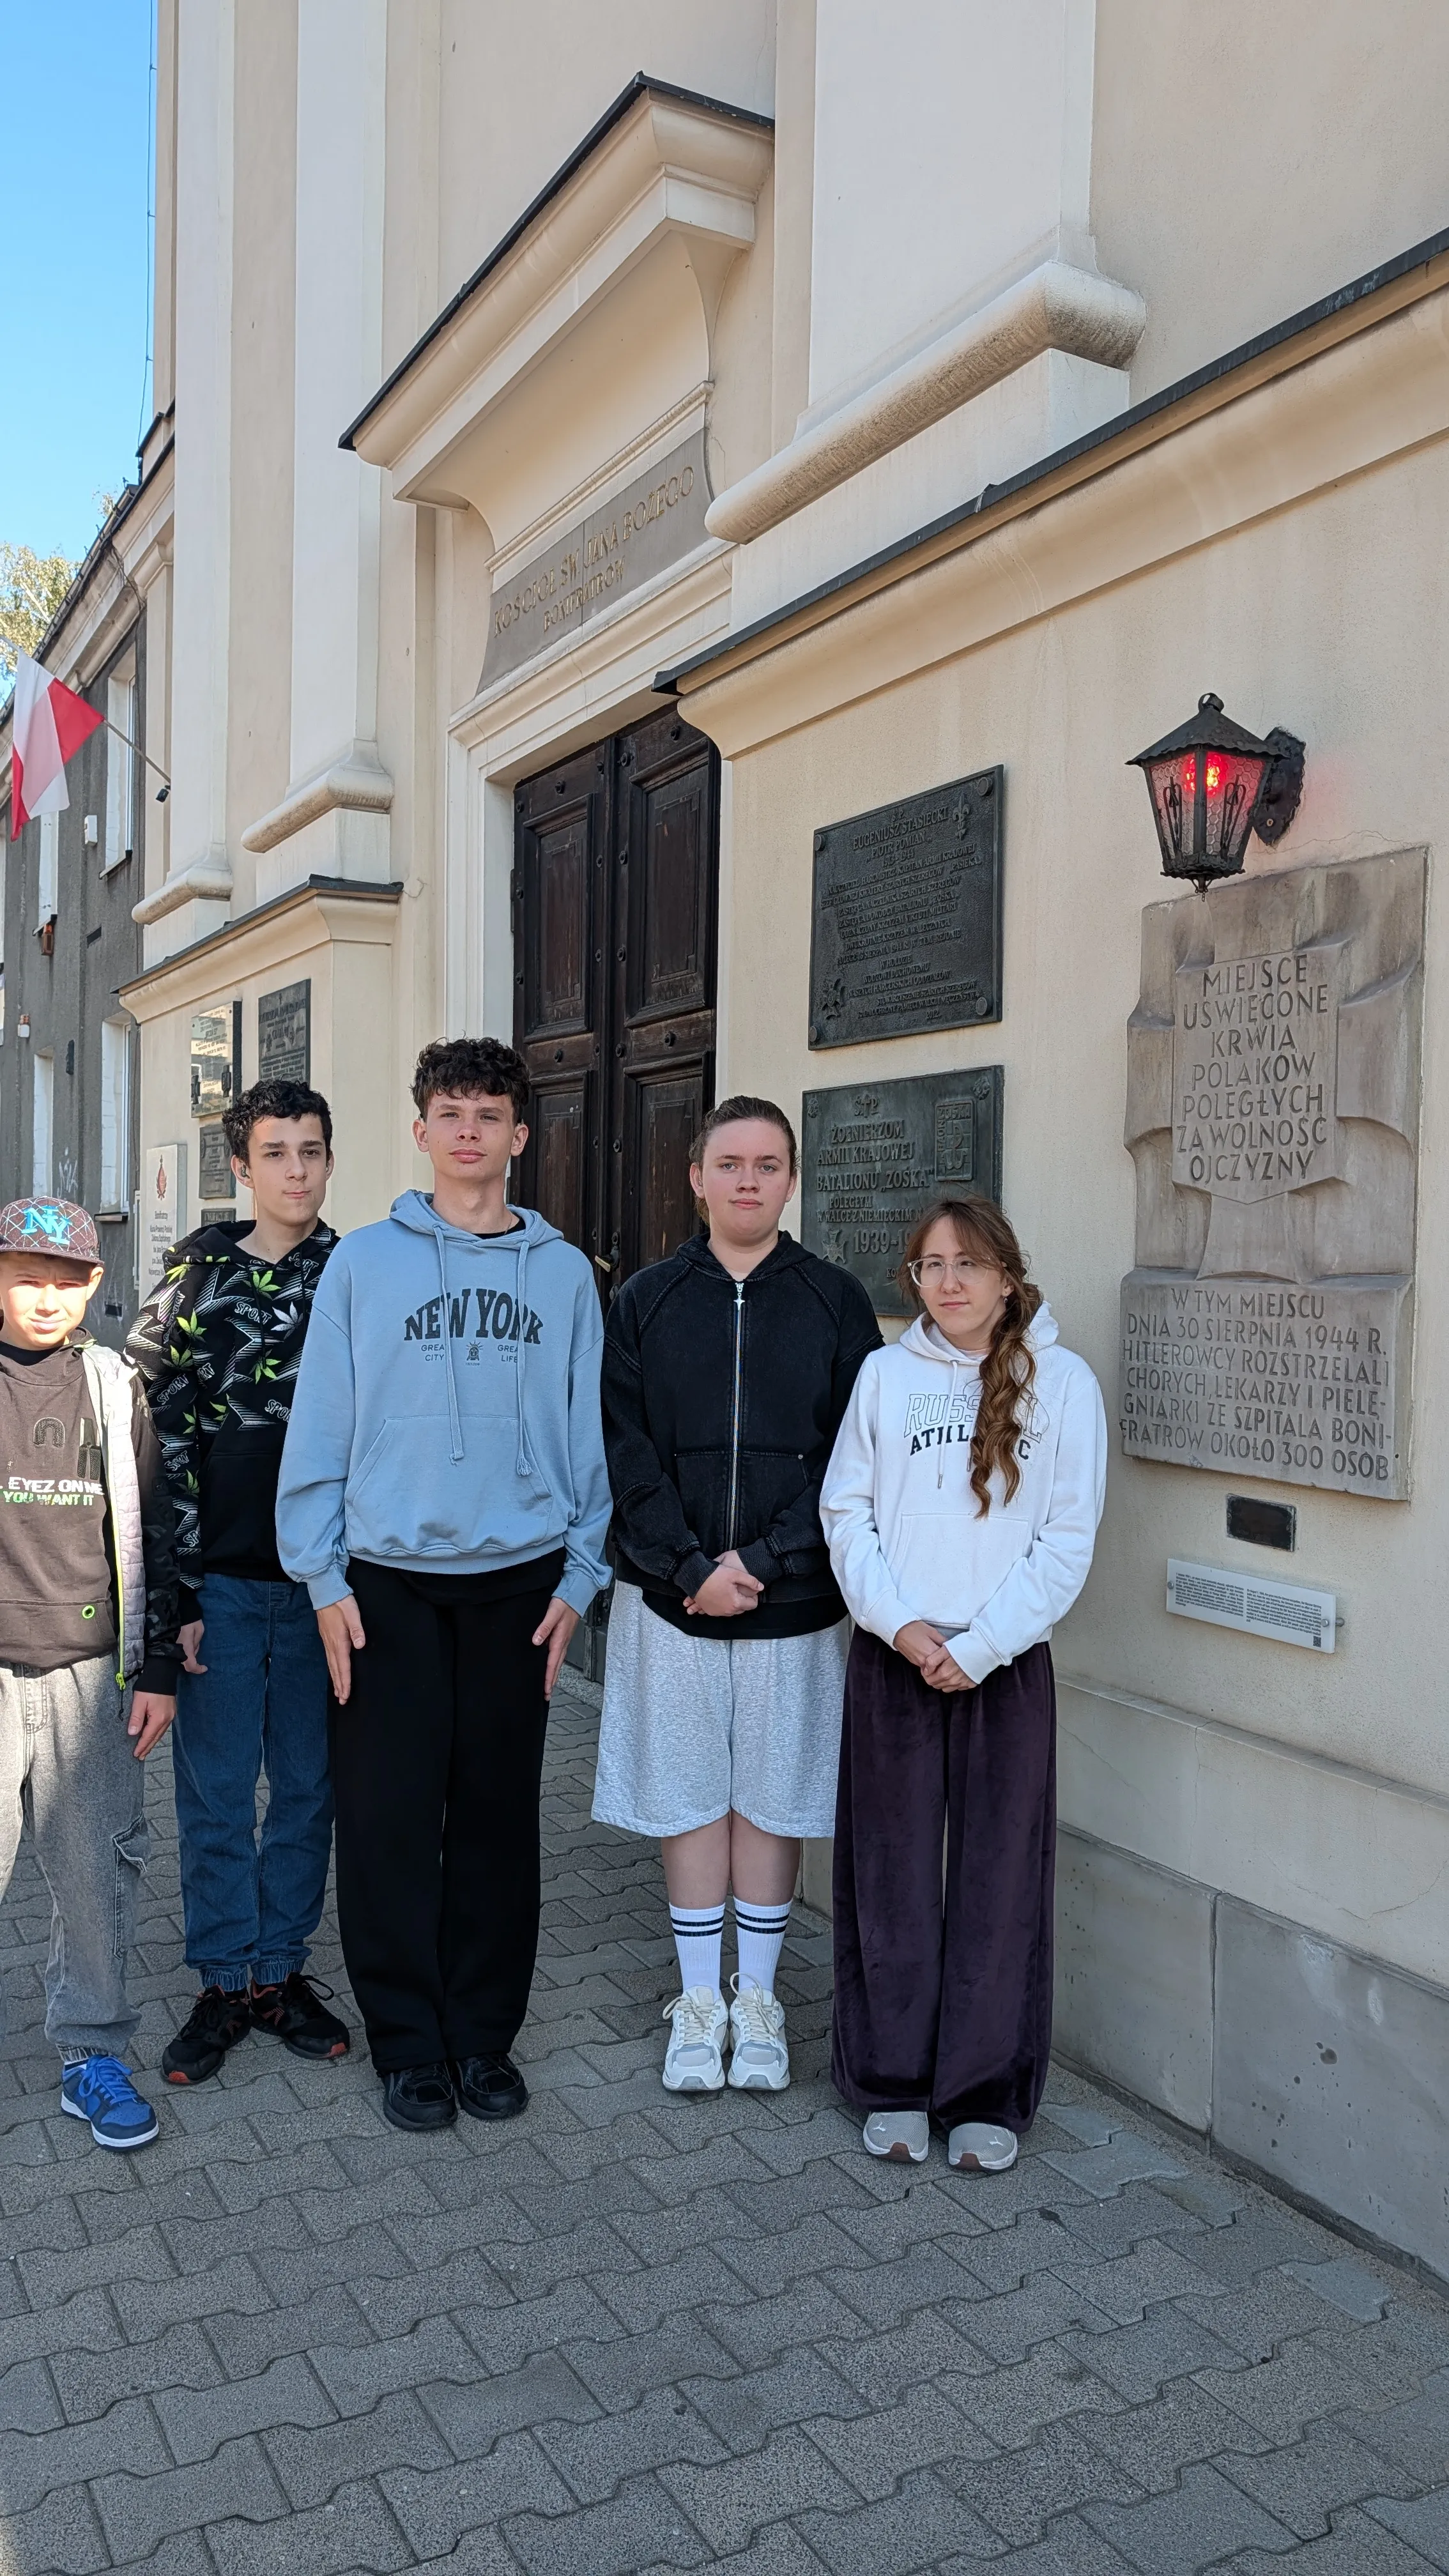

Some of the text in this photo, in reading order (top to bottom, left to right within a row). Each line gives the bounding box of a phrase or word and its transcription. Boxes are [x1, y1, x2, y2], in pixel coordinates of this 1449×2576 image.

[583, 520, 618, 569] JANA
[623, 466, 694, 542] BOŻEGO
[852, 804, 949, 851] EUGENIUSZ STASIECKI
[1202, 954, 1308, 997] MIEJSCE
[1211, 1024, 1298, 1058] KRWIĄ
[1192, 1052, 1315, 1091] POLAKÓW
[1182, 1084, 1323, 1121] POLEGŁYCH
[832, 1120, 905, 1144] ŻOŁNIERZOM
[1176, 1115, 1328, 1153] ZA WOLNOŚĆ
[816, 1142, 916, 1167] ARMII KRAJOWEJ
[1190, 1150, 1314, 1184] OJCZYZNY
[816, 1172, 880, 1192] BATALIONU
[825, 1209, 850, 1223] WALCE
[859, 1208, 913, 1223] NIEMIECKIM
[829, 1195, 873, 1209] POLEGŁYM
[404, 1288, 544, 1345] NEW YORK
[1171, 1288, 1324, 1319] W TYM MIEJSCU
[421, 1343, 447, 1352] GREA
[1128, 1313, 1387, 1356] DNIA 30 SIERPNIA 1944 R.
[425, 1354, 518, 1363] CITY LIFE
[1123, 1339, 1390, 1387] HITLEROWCY ROZSTRZELALI
[1215, 1375, 1301, 1406] LEKARZY
[1308, 1384, 1313, 1409] I
[1124, 1392, 1392, 1449] GNIARKI ZE SZPITALA BONI-
[1211, 1431, 1275, 1463] OKOŁO
[1282, 1441, 1324, 1470] 300
[1331, 1449, 1389, 1481] OSÓB
[3, 1491, 94, 1506] YOU WANT IT
[8, 1476, 56, 1493] EYEZ
[57, 1480, 84, 1493] ON
